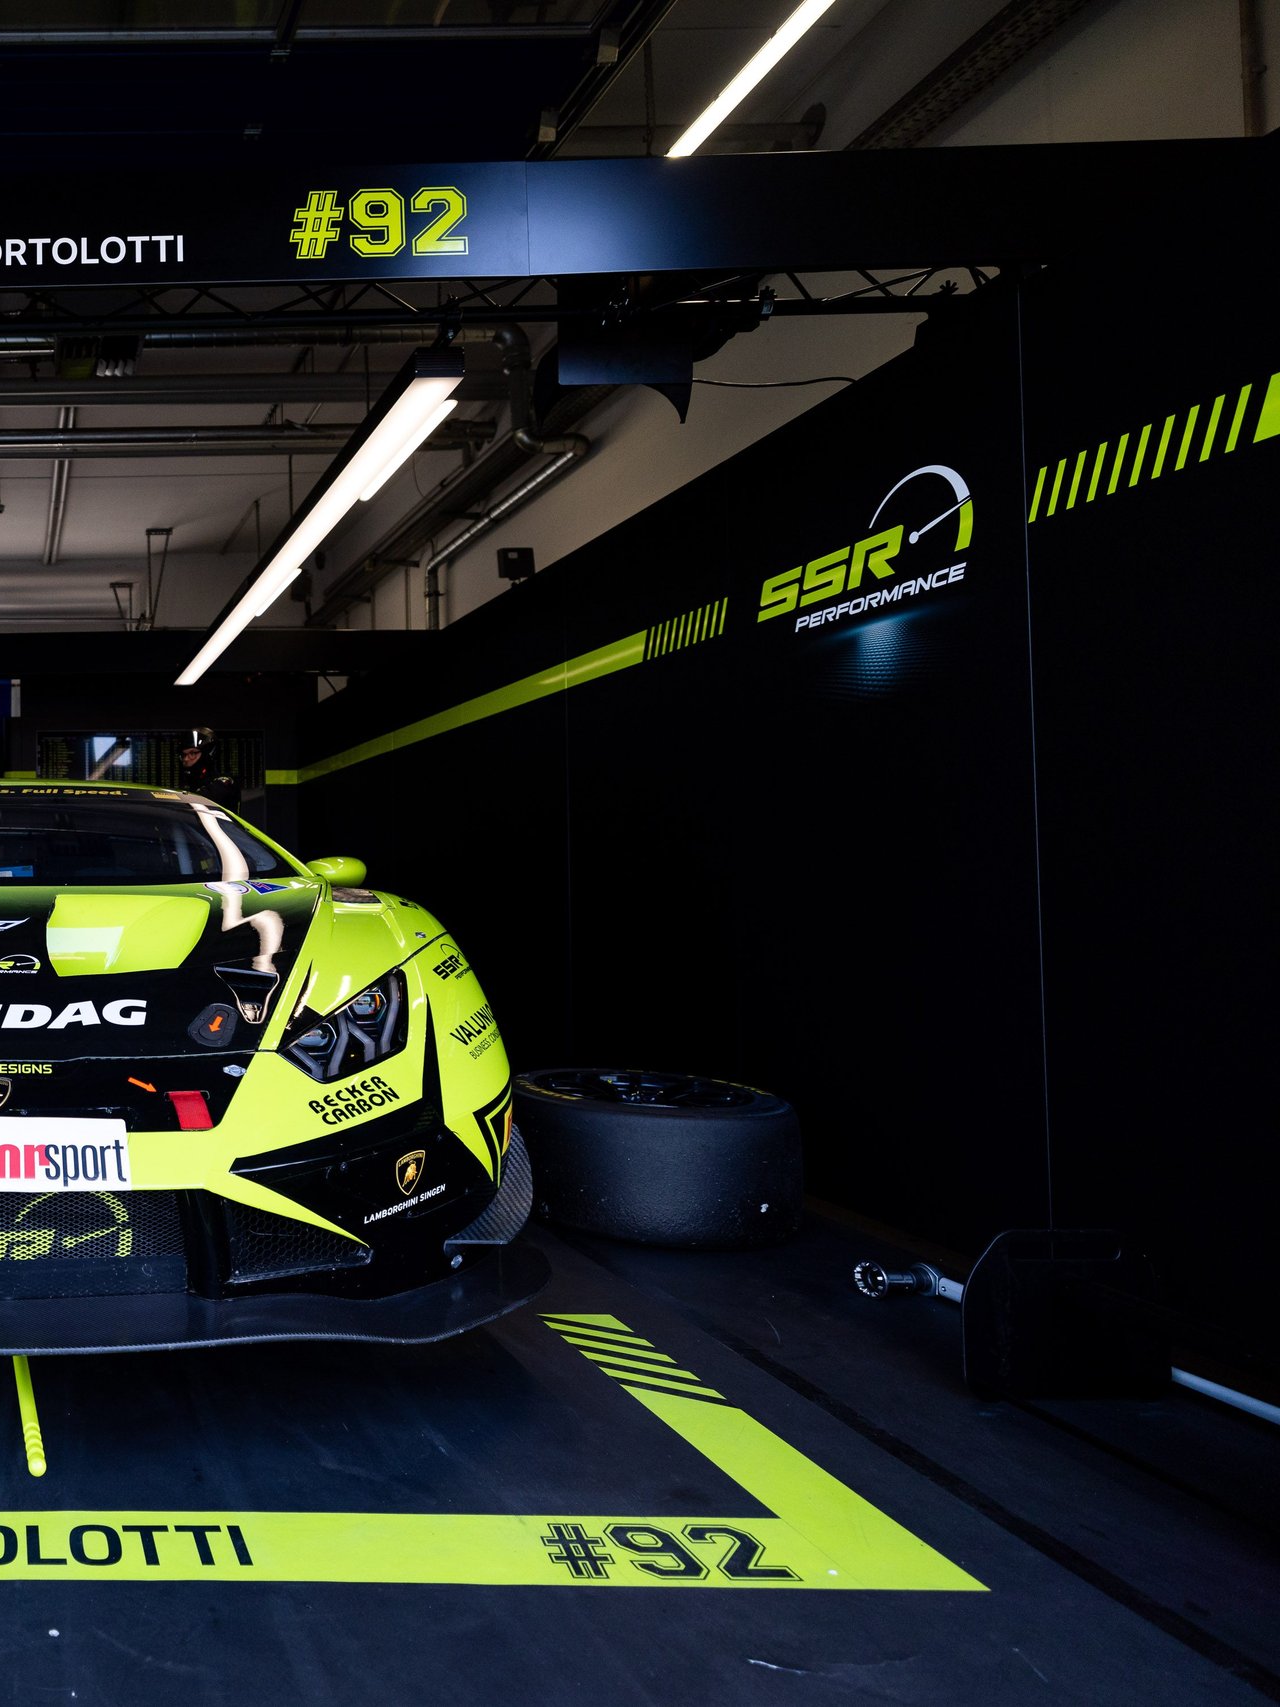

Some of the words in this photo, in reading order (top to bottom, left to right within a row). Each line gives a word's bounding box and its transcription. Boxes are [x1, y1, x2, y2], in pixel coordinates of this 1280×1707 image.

[289, 186, 469, 259] #92
[757, 524, 904, 623] SSR
[795, 561, 967, 633] PERFORMANCE
[432, 954, 463, 980] SSR
[308, 1076, 388, 1114] BECKER
[322, 1087, 400, 1125] CARBON
[363, 1195, 418, 1224] LAMBORGHINI
[419, 1183, 446, 1201] SINGEN
[540, 1522, 804, 1582] #92
